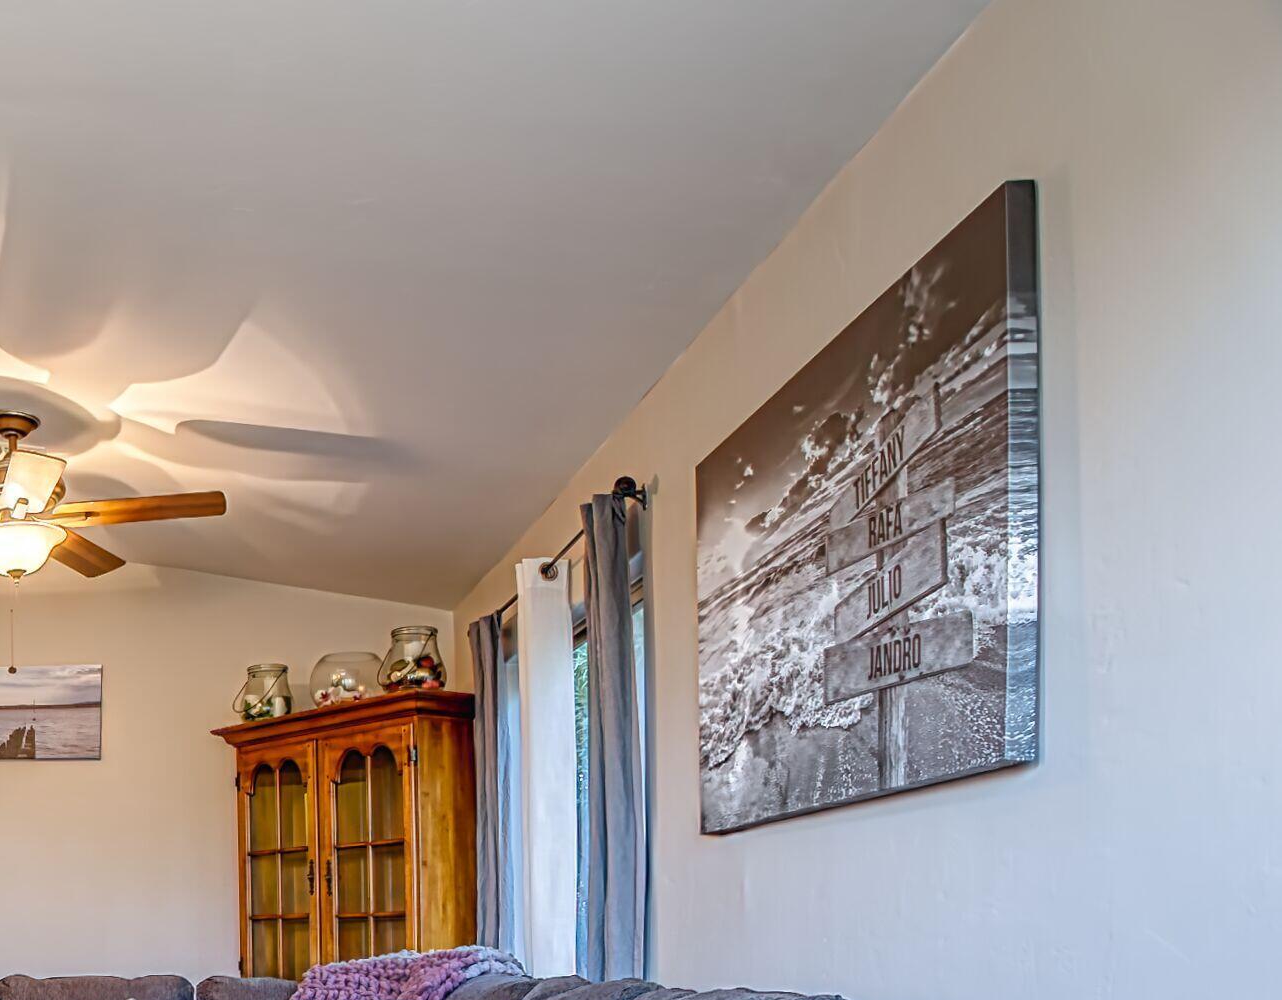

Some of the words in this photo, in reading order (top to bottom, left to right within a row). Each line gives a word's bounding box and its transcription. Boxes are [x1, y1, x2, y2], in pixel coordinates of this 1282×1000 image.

[853, 425, 905, 510] TIFFANY
[868, 502, 903, 549] RAFA
[867, 564, 902, 621] JULIO
[868, 633, 921, 682] JANDRO
